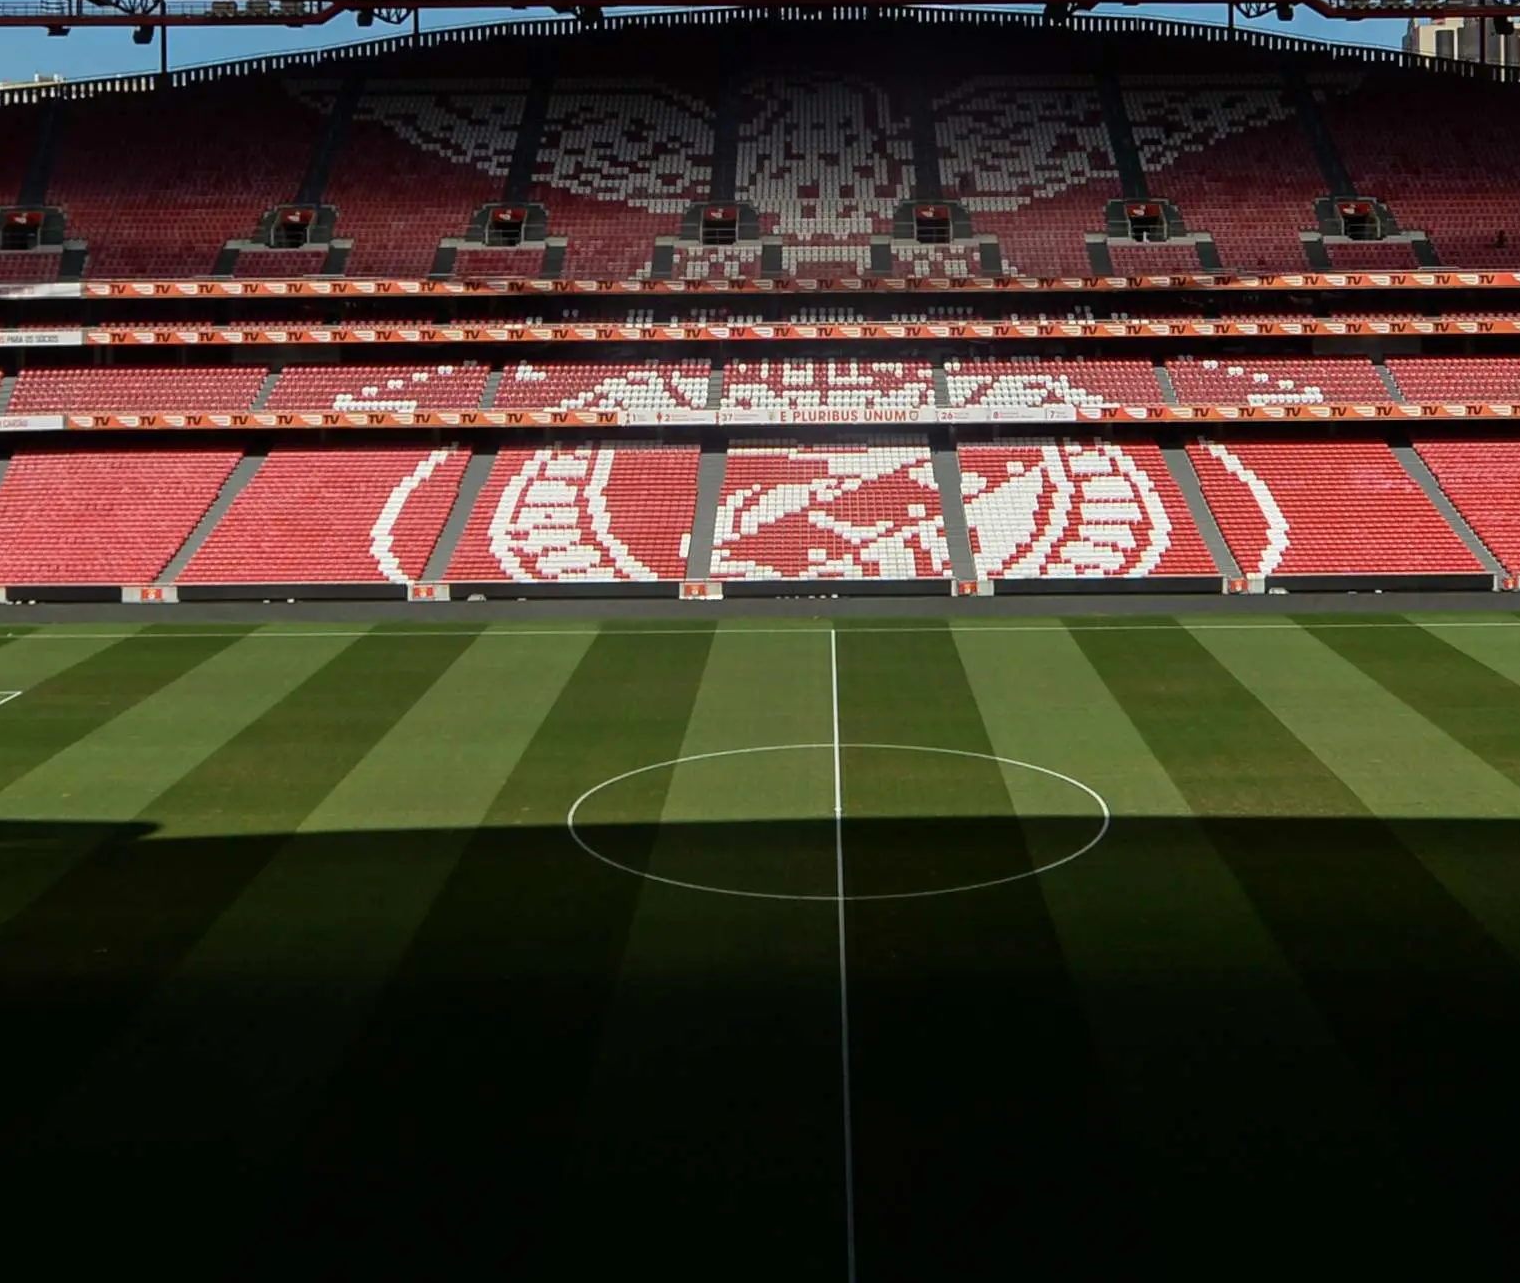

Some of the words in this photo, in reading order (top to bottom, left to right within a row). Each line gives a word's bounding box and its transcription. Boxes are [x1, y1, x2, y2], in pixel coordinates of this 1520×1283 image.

[780, 410, 787, 422] E
[792, 410, 859, 422] PLURIBUS
[863, 409, 907, 422] UNUM
